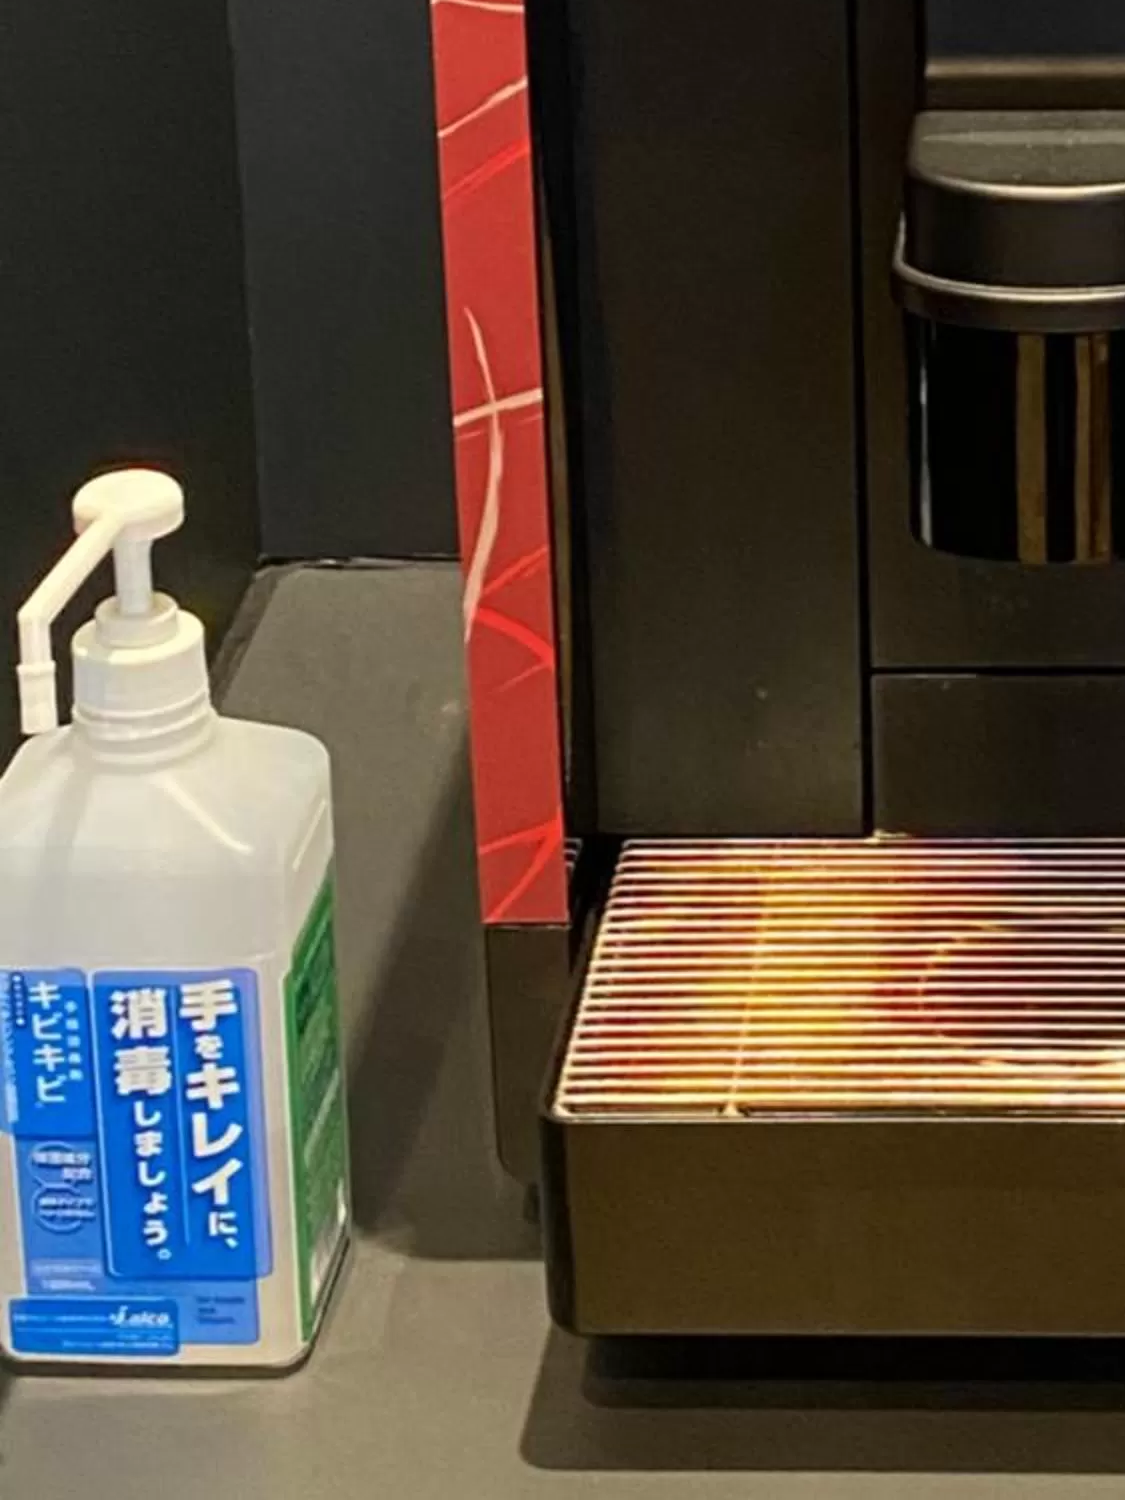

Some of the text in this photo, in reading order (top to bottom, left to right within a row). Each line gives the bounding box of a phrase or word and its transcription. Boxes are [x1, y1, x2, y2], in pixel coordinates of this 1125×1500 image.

[109, 987, 173, 1261] 消毒しましょう。
[178, 978, 244, 1249] 手をキレイに、
